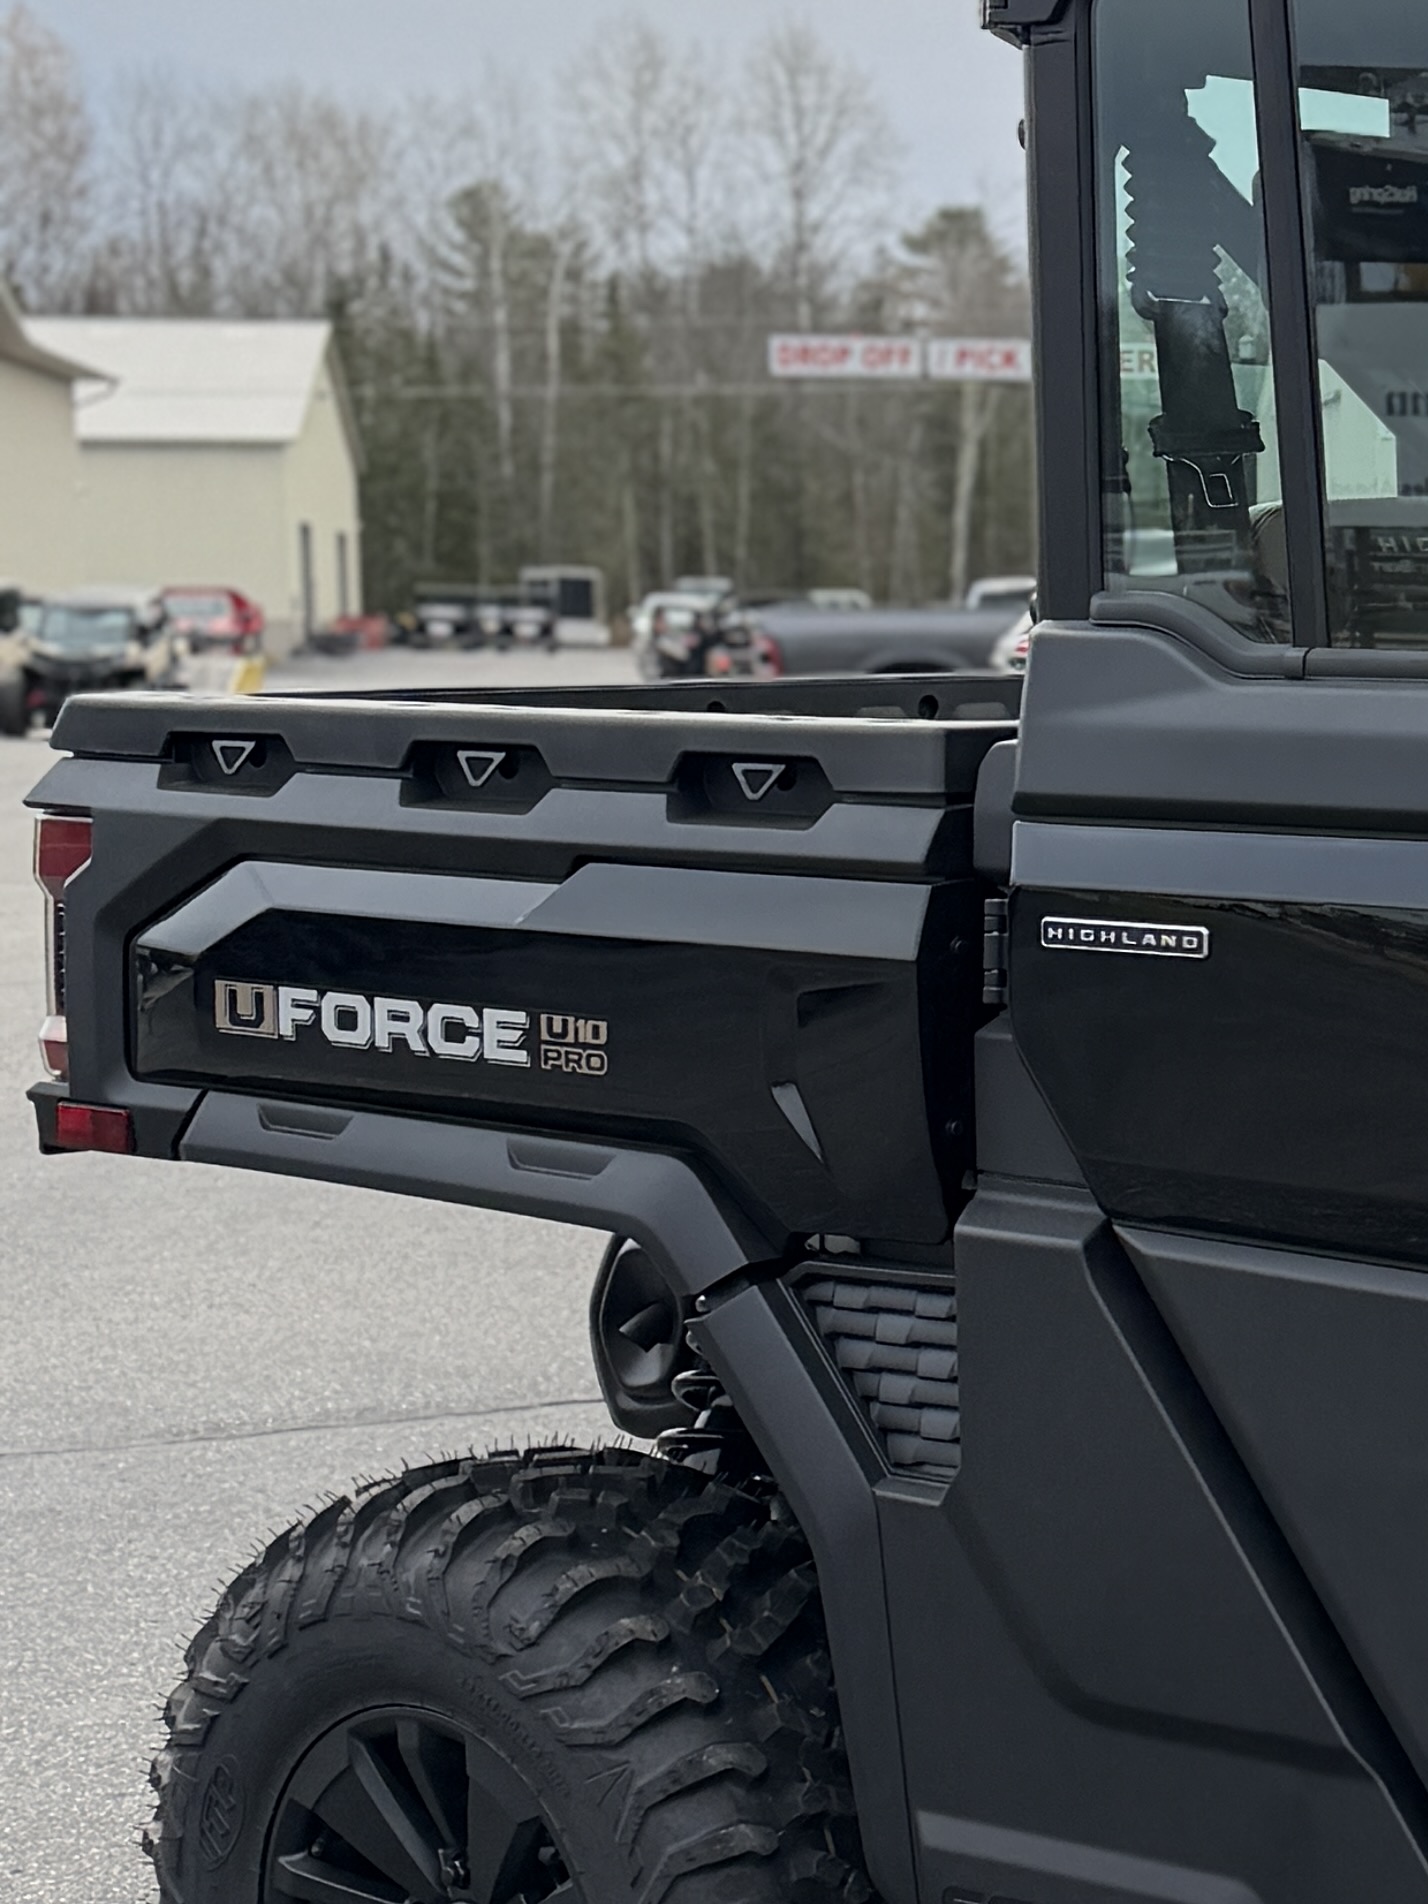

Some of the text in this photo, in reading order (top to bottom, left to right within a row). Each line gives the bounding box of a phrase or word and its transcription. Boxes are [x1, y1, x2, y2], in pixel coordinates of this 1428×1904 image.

[955, 347, 1018, 371] PICK
[1047, 925, 1199, 950] HIGHLAND
[539, 1013, 608, 1047] U10
[539, 1046, 608, 1077] PRO
